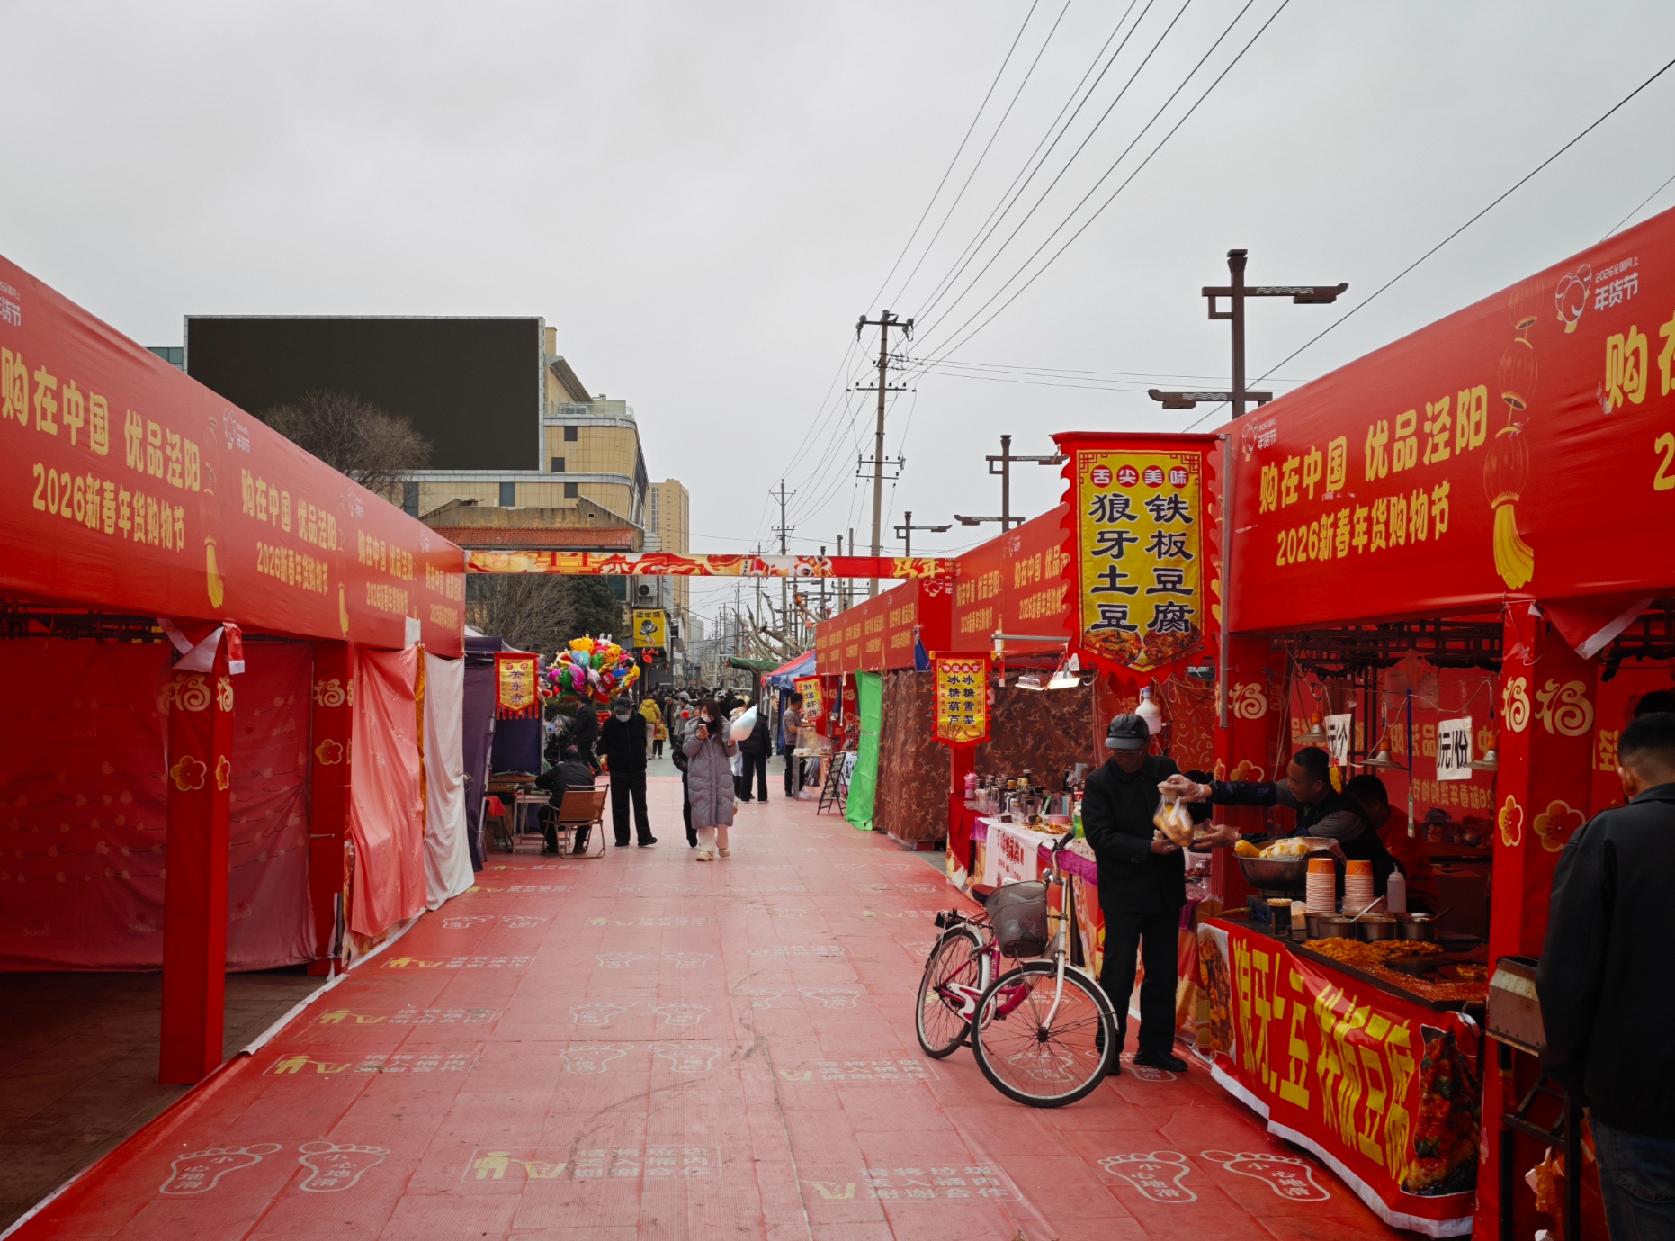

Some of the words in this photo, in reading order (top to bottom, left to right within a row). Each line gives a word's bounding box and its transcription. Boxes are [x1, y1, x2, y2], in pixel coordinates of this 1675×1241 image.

[0, 295, 22, 328] 货节
[1594, 272, 1638, 310] 年货节
[1, 347, 109, 456] 购在中国
[124, 409, 201, 492] 优品泾阳
[1259, 435, 1348, 515] 购在中国
[1365, 385, 1488, 482] 优品泾阳
[32, 463, 185, 552] 2026新春年货购物节
[241, 469, 291, 532] 购在中国
[298, 500, 337, 551] 优品泾阳
[1092, 467, 1188, 485] 舌尖美味
[1088, 494, 1139, 633] 狼牙土豆
[1144, 493, 1195, 633] 铁板豆腐
[1276, 480, 1450, 567] 2026新春年货购物节
